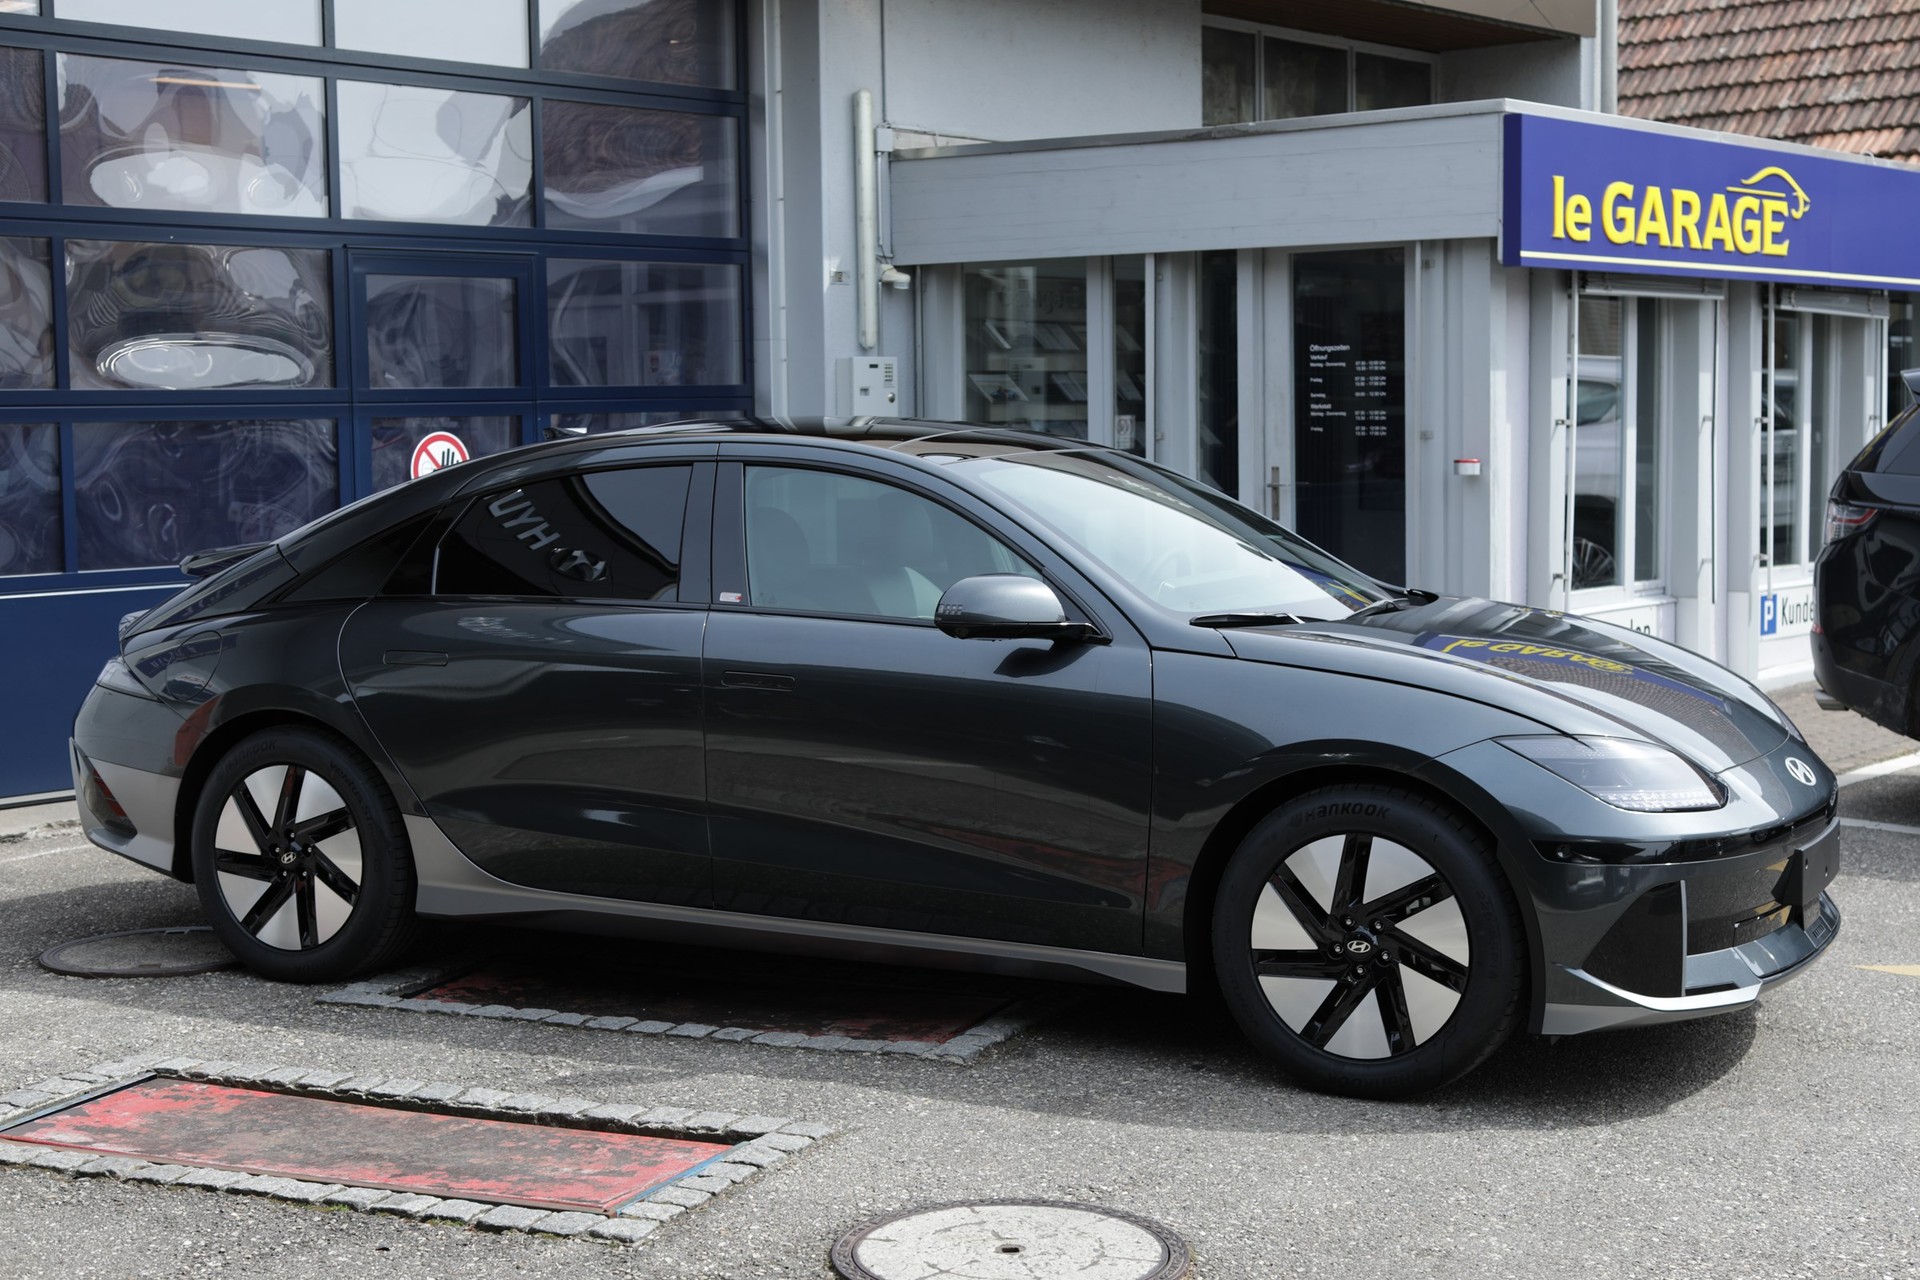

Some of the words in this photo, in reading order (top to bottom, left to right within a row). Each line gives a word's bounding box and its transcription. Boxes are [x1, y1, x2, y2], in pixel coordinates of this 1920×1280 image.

[1552, 175, 1592, 242] le
[1602, 181, 1790, 256] GARAGE
[1309, 344, 1351, 353] Öffnungszeiten
